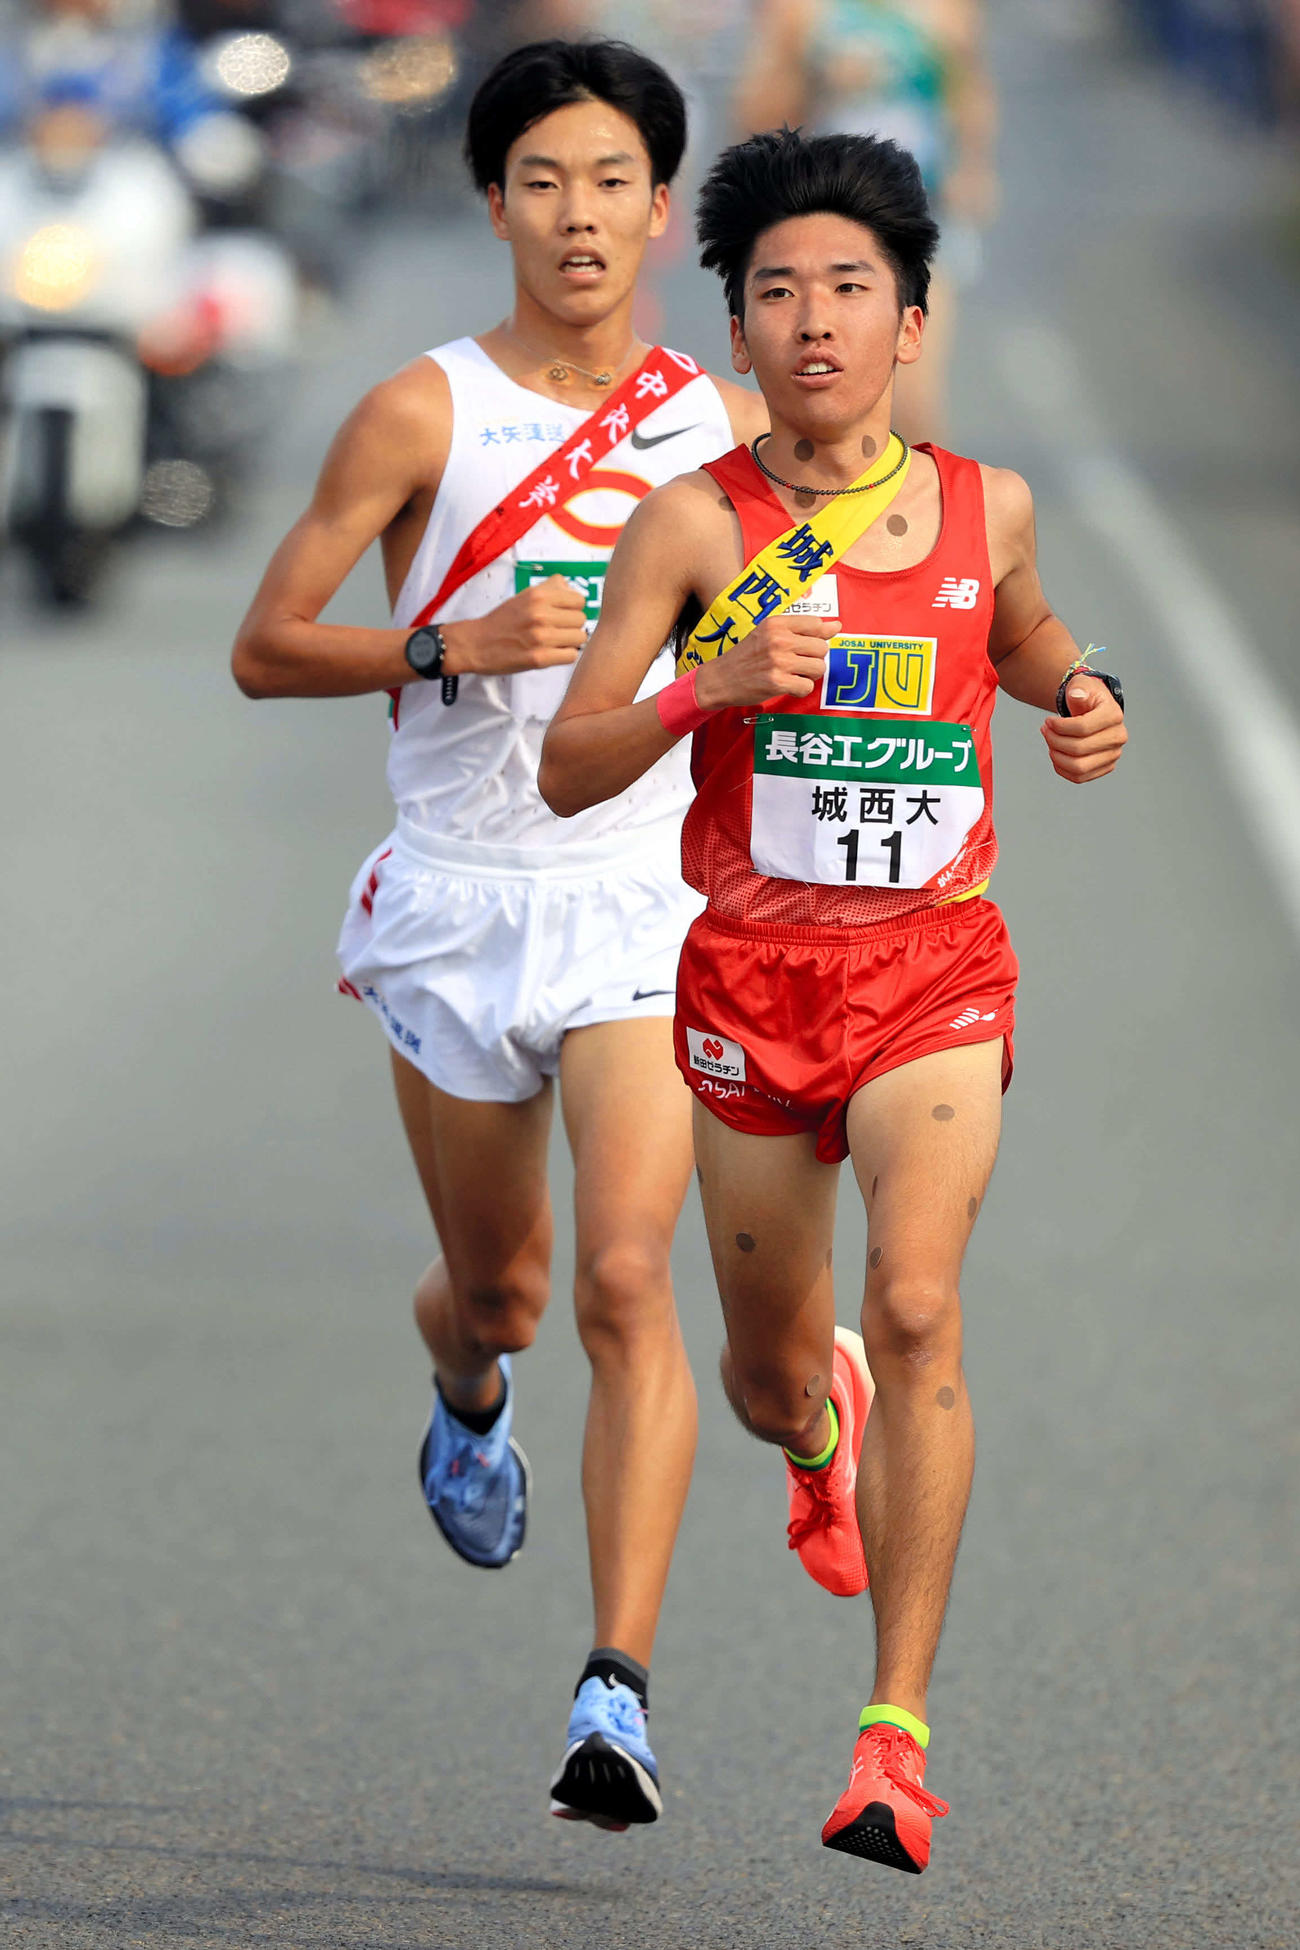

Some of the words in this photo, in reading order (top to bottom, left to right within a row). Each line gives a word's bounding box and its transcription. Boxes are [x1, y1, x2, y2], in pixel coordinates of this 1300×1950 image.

[518, 369, 668, 508] 中央大学
[839, 640, 866, 648] JOSAI
[869, 641, 924, 650] UNIVERSITY
[835, 650, 924, 708] JU
[765, 730, 972, 773] 長谷工グループ
[812, 785, 941, 826] 城西大
[837, 829, 902, 883] 11
